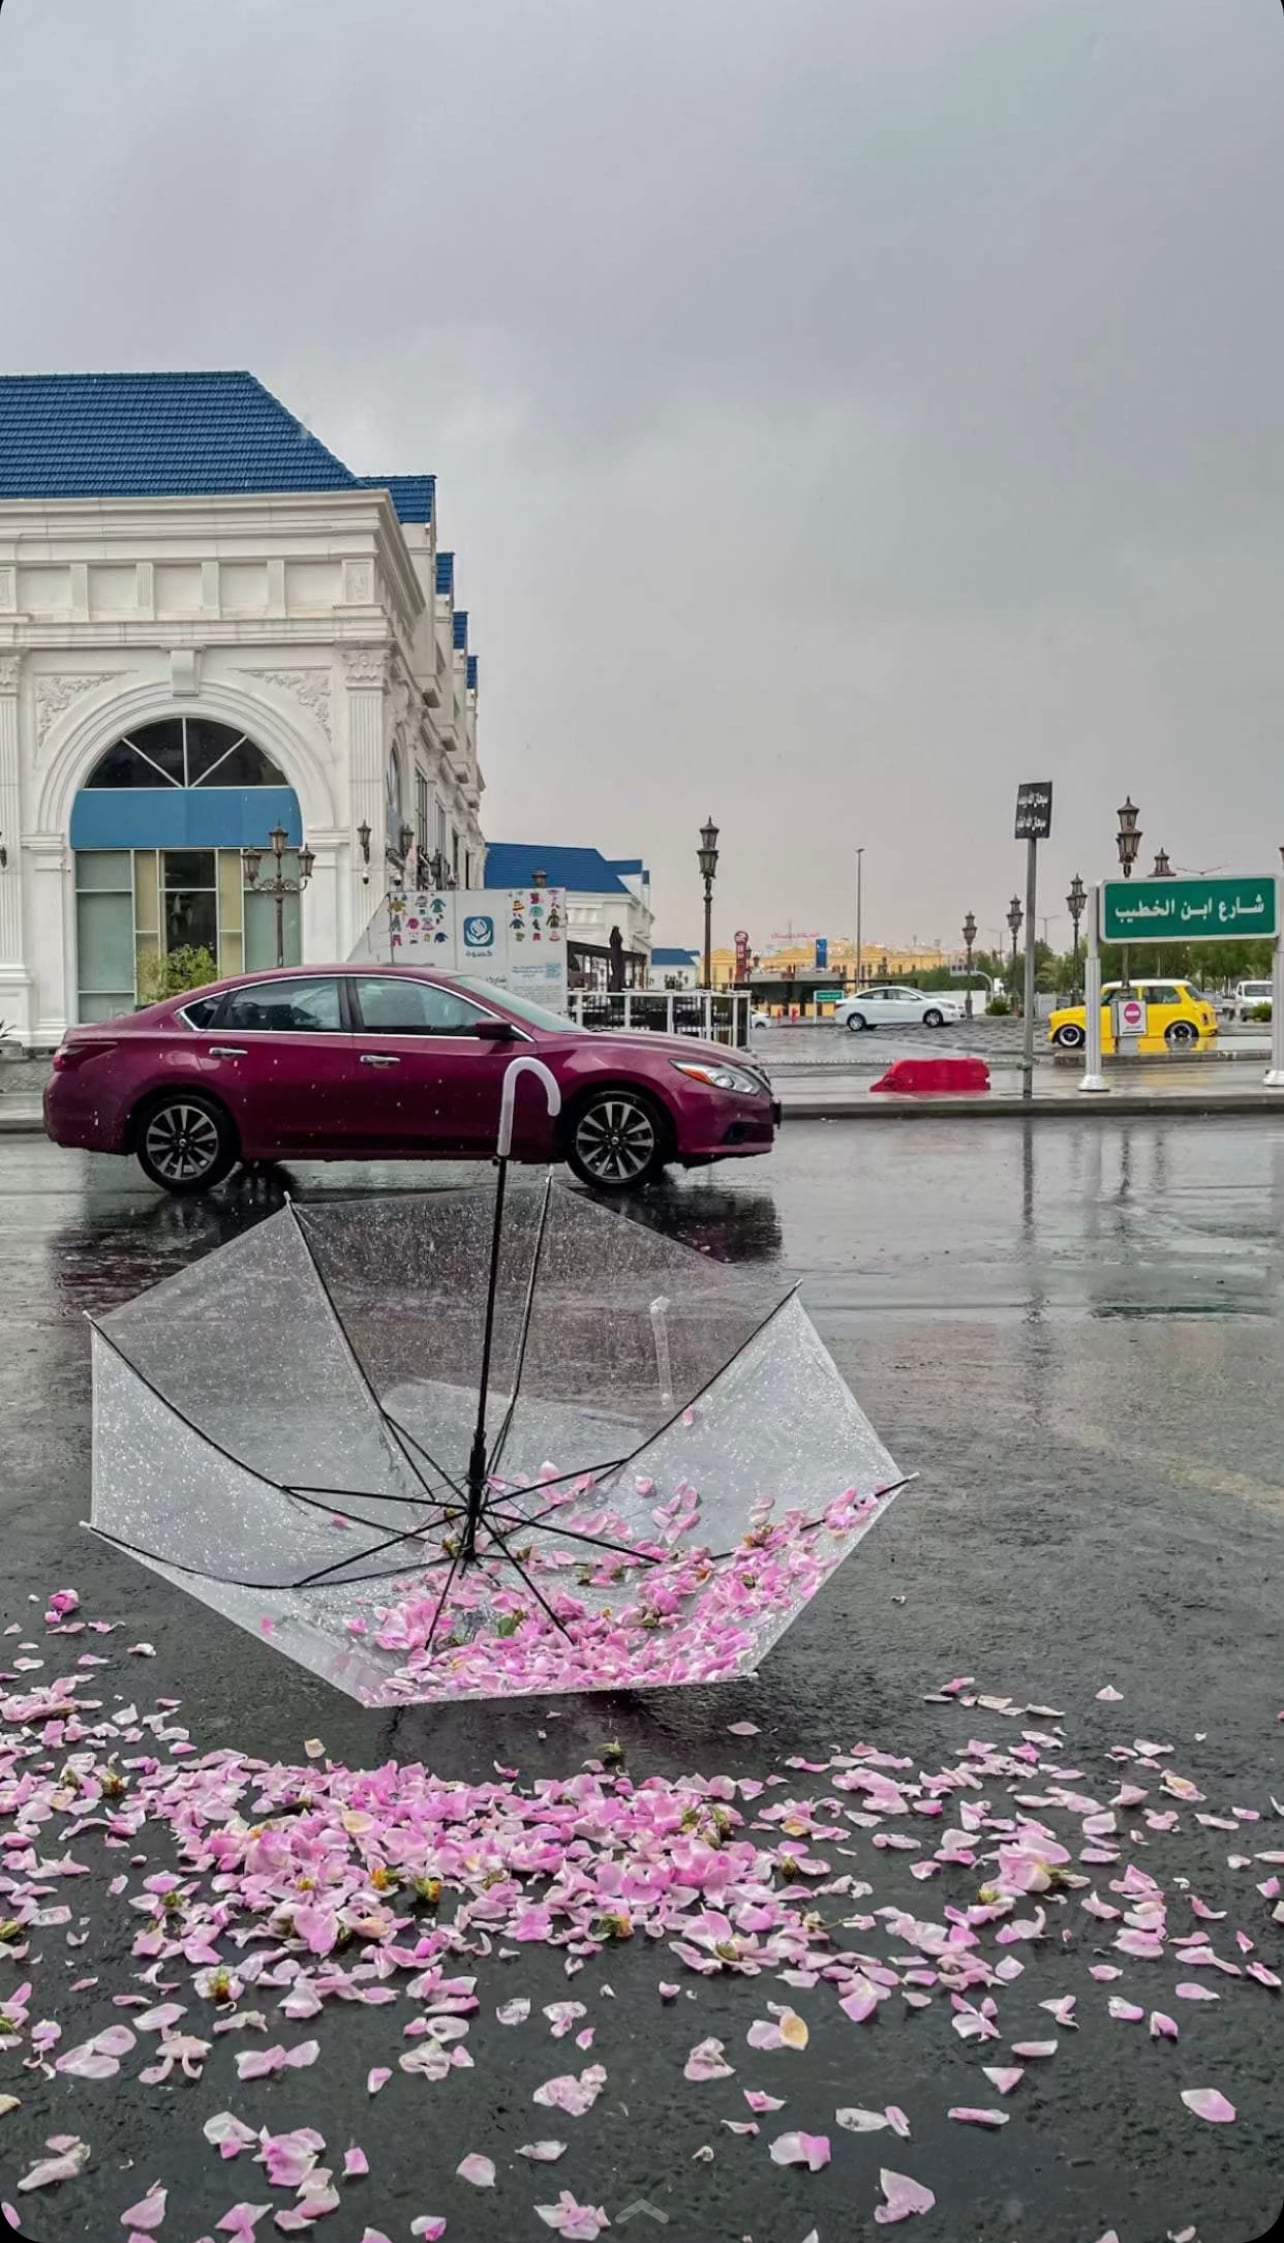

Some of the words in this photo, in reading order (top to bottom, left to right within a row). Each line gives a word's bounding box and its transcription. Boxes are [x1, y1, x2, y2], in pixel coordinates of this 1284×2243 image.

[1115, 897, 1175, 923] الخطيب
[1180, 896, 1212, 920] ابن
[1218, 893, 1264, 922] شارع
